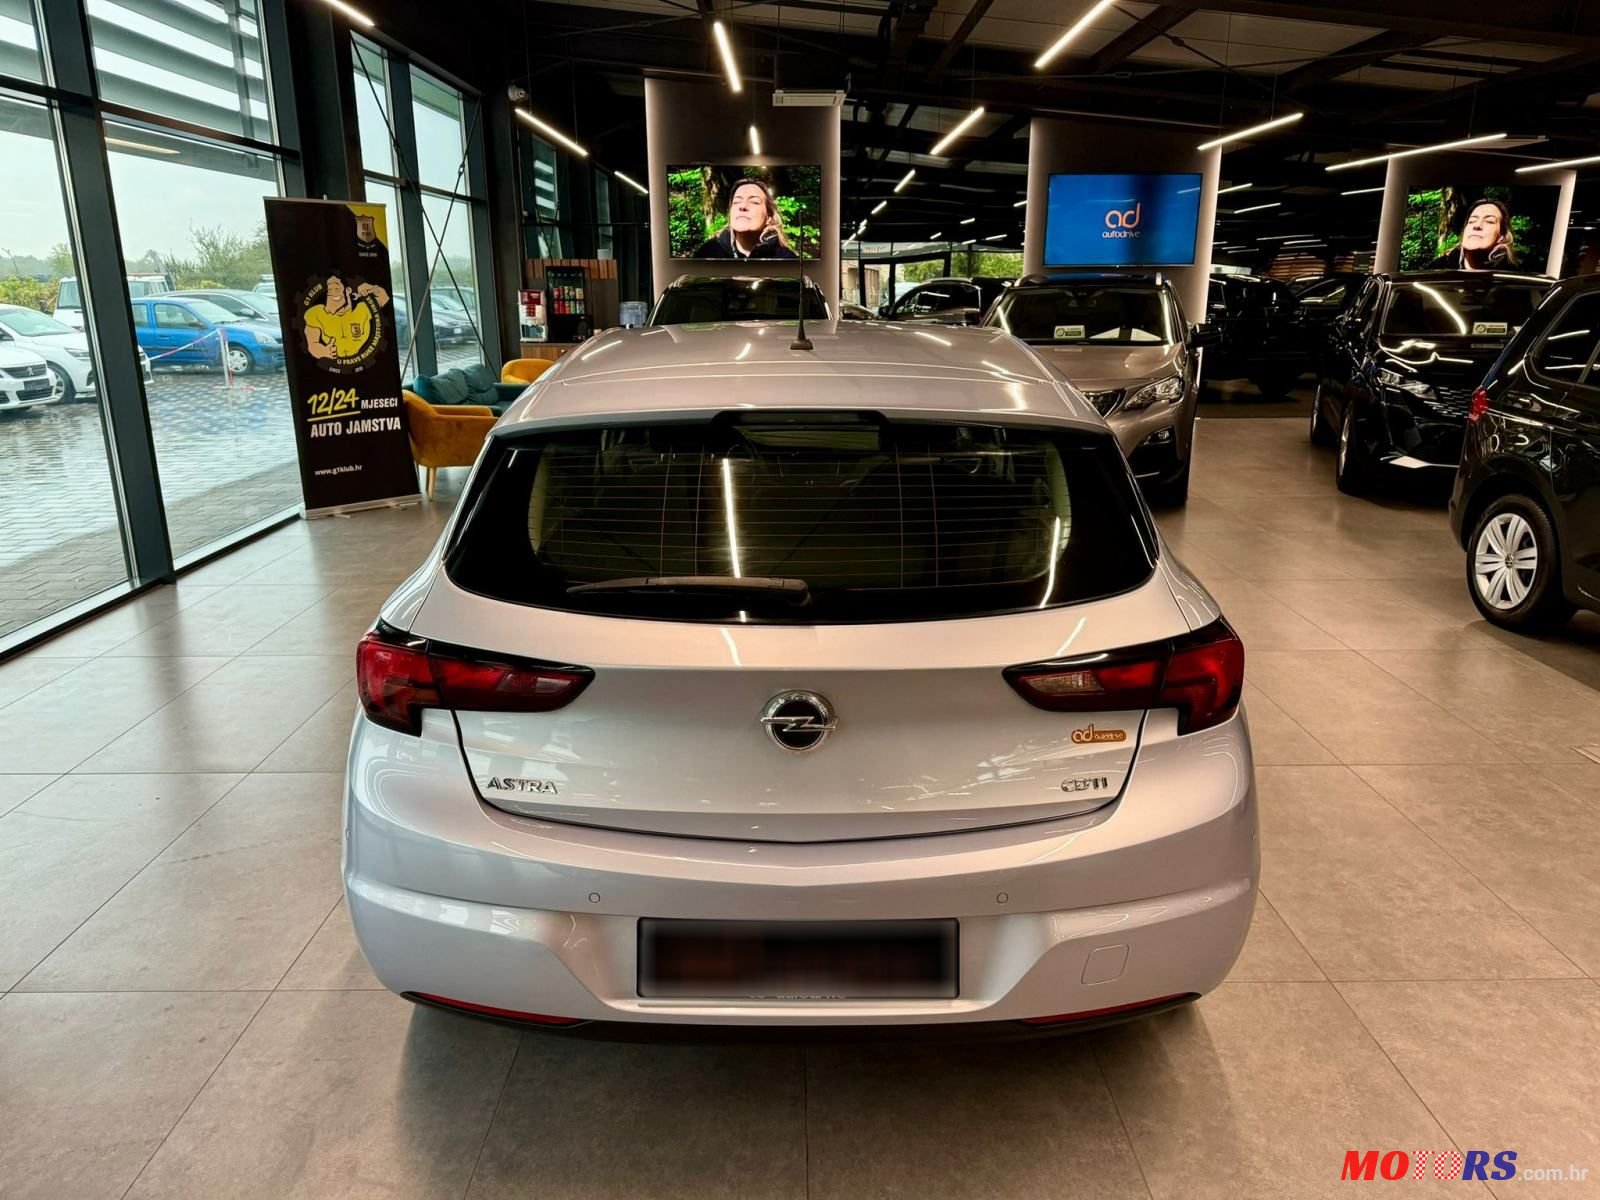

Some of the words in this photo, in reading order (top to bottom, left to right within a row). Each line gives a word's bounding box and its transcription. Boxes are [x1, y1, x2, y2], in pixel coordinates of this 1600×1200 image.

[1105, 202, 1141, 228] ad
[307, 387, 360, 415] 12/24
[361, 397, 398, 410] MJESECI
[310, 421, 342, 438] AUTO
[346, 417, 401, 435] JAMSTVA
[314, 464, 363, 476] www.g1klub.hr
[486, 776, 558, 795] ASTRA
